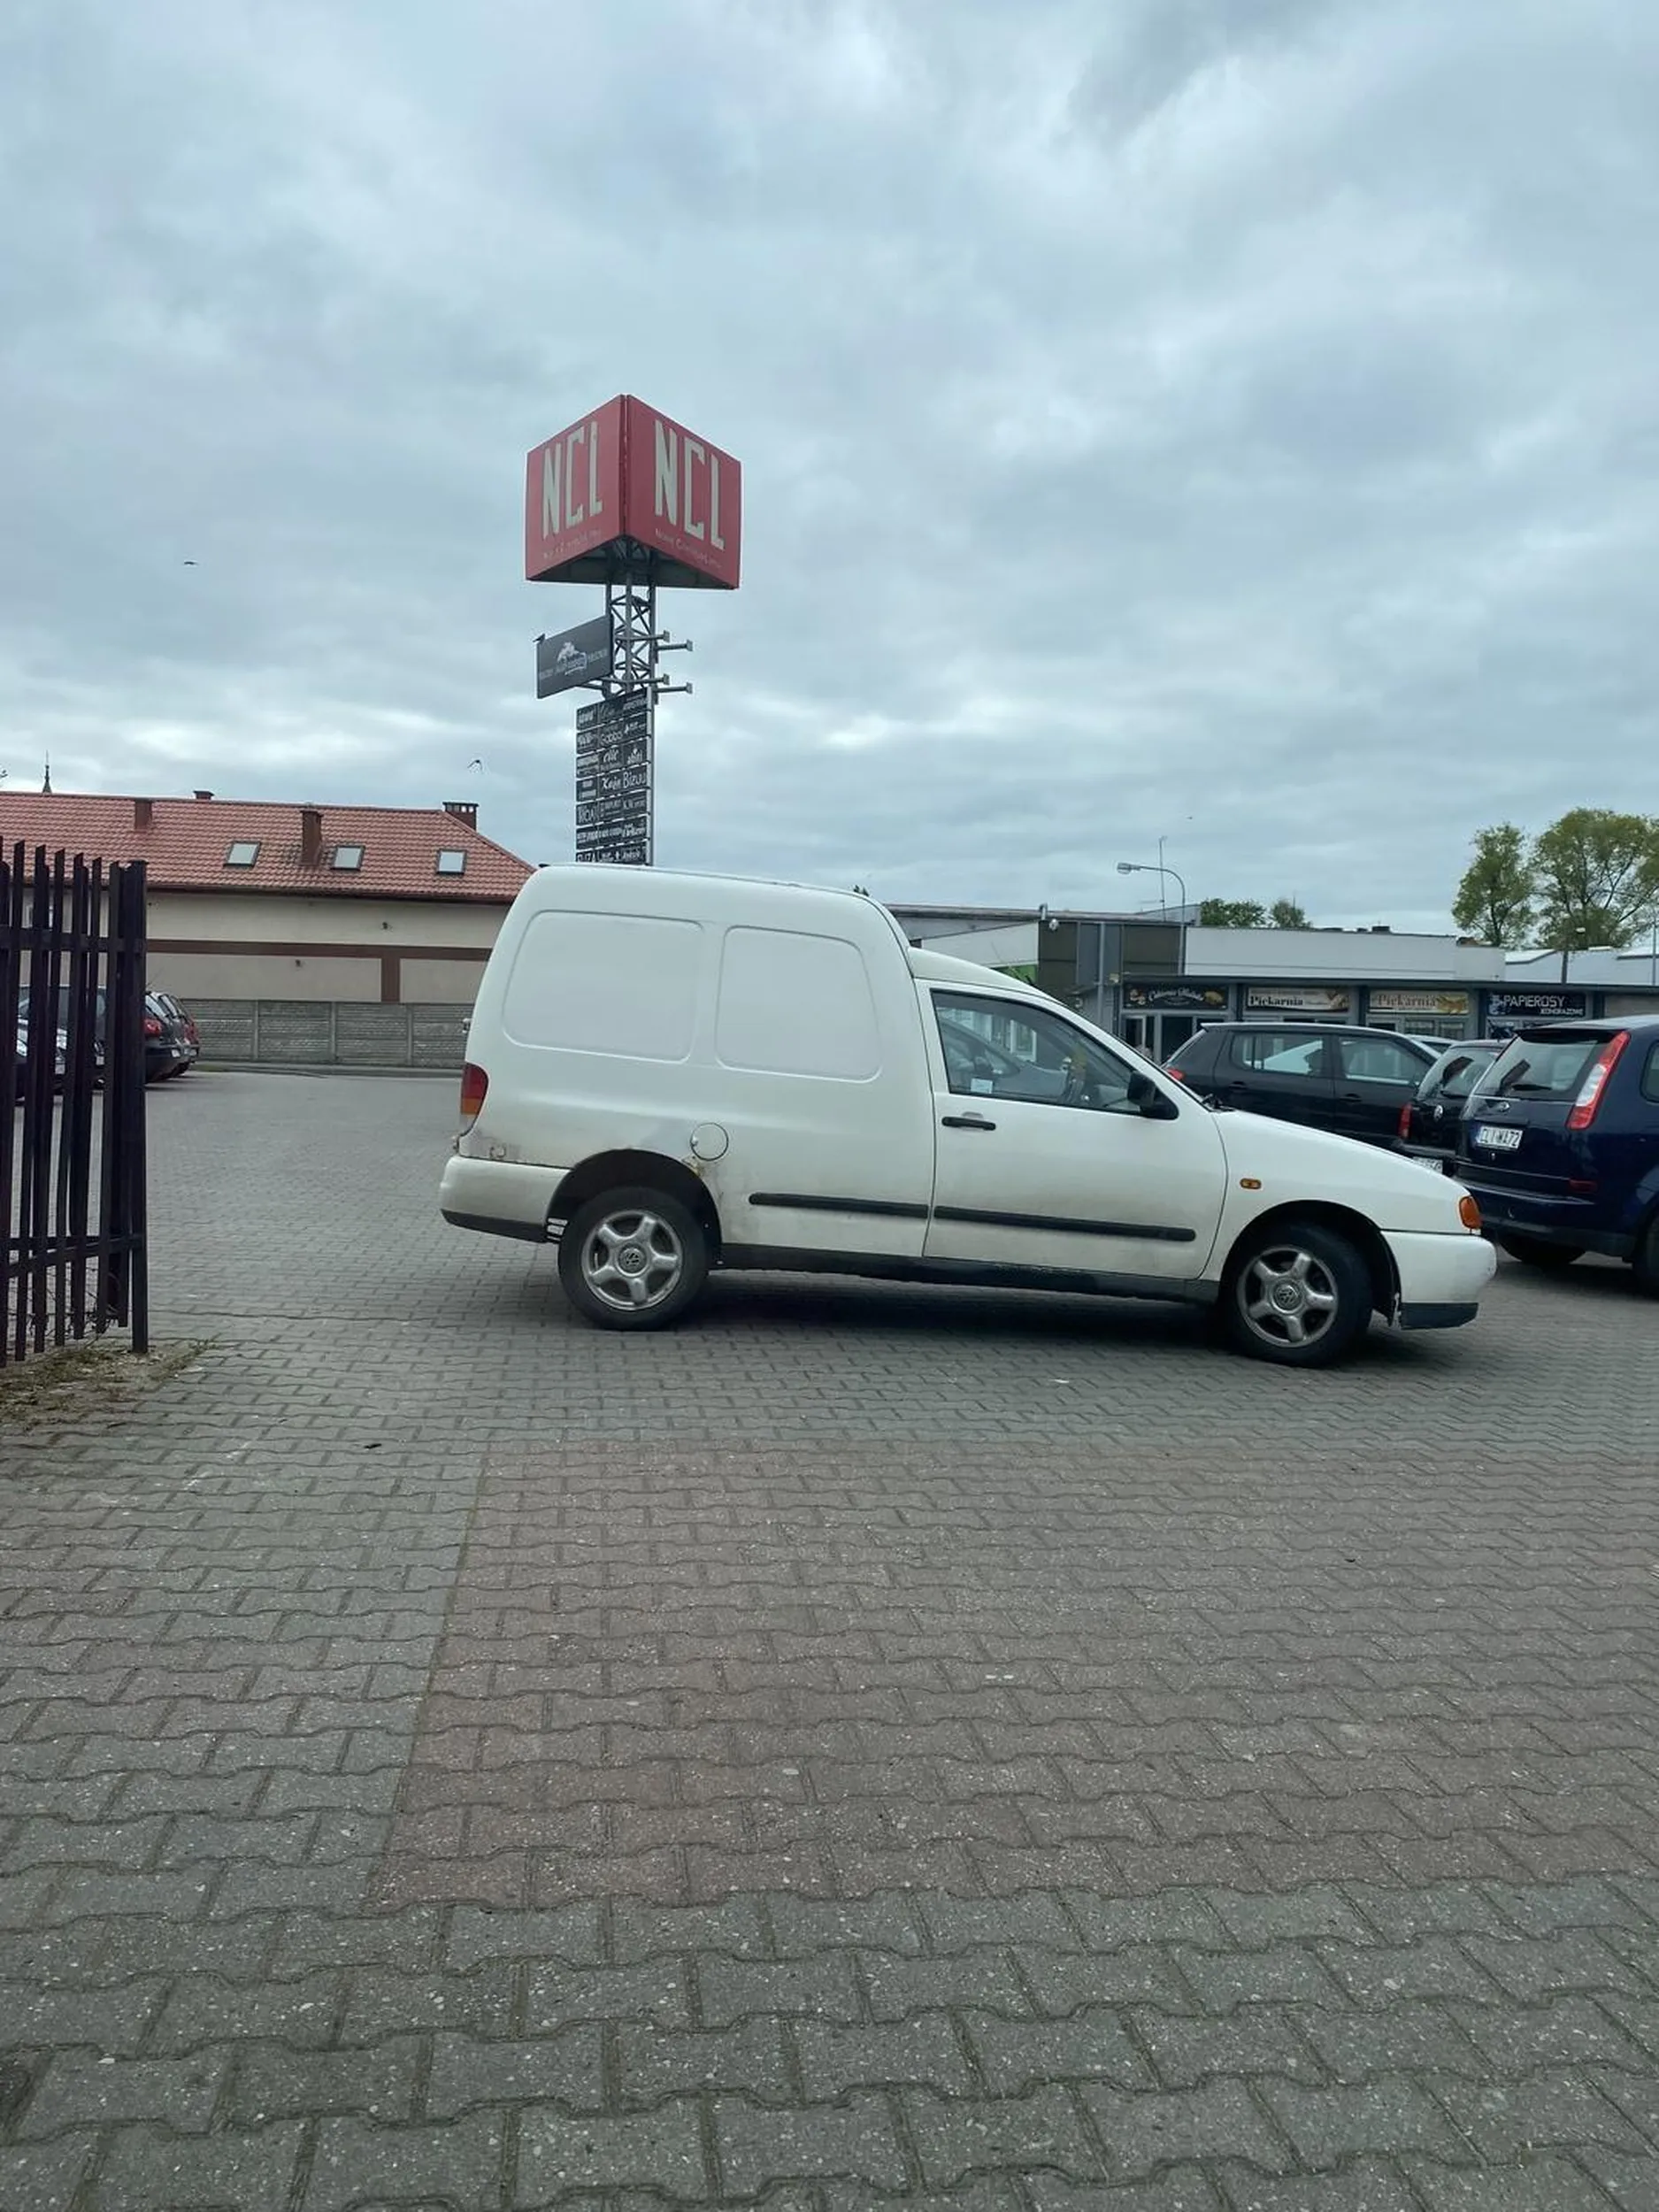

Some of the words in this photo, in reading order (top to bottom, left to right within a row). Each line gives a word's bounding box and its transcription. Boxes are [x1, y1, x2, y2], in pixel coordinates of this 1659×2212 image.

[542, 420, 603, 541] NCL
[655, 419, 726, 550] NCL
[1249, 995, 1303, 1006] Piekarnia
[1378, 994, 1436, 1007] Piekarnia
